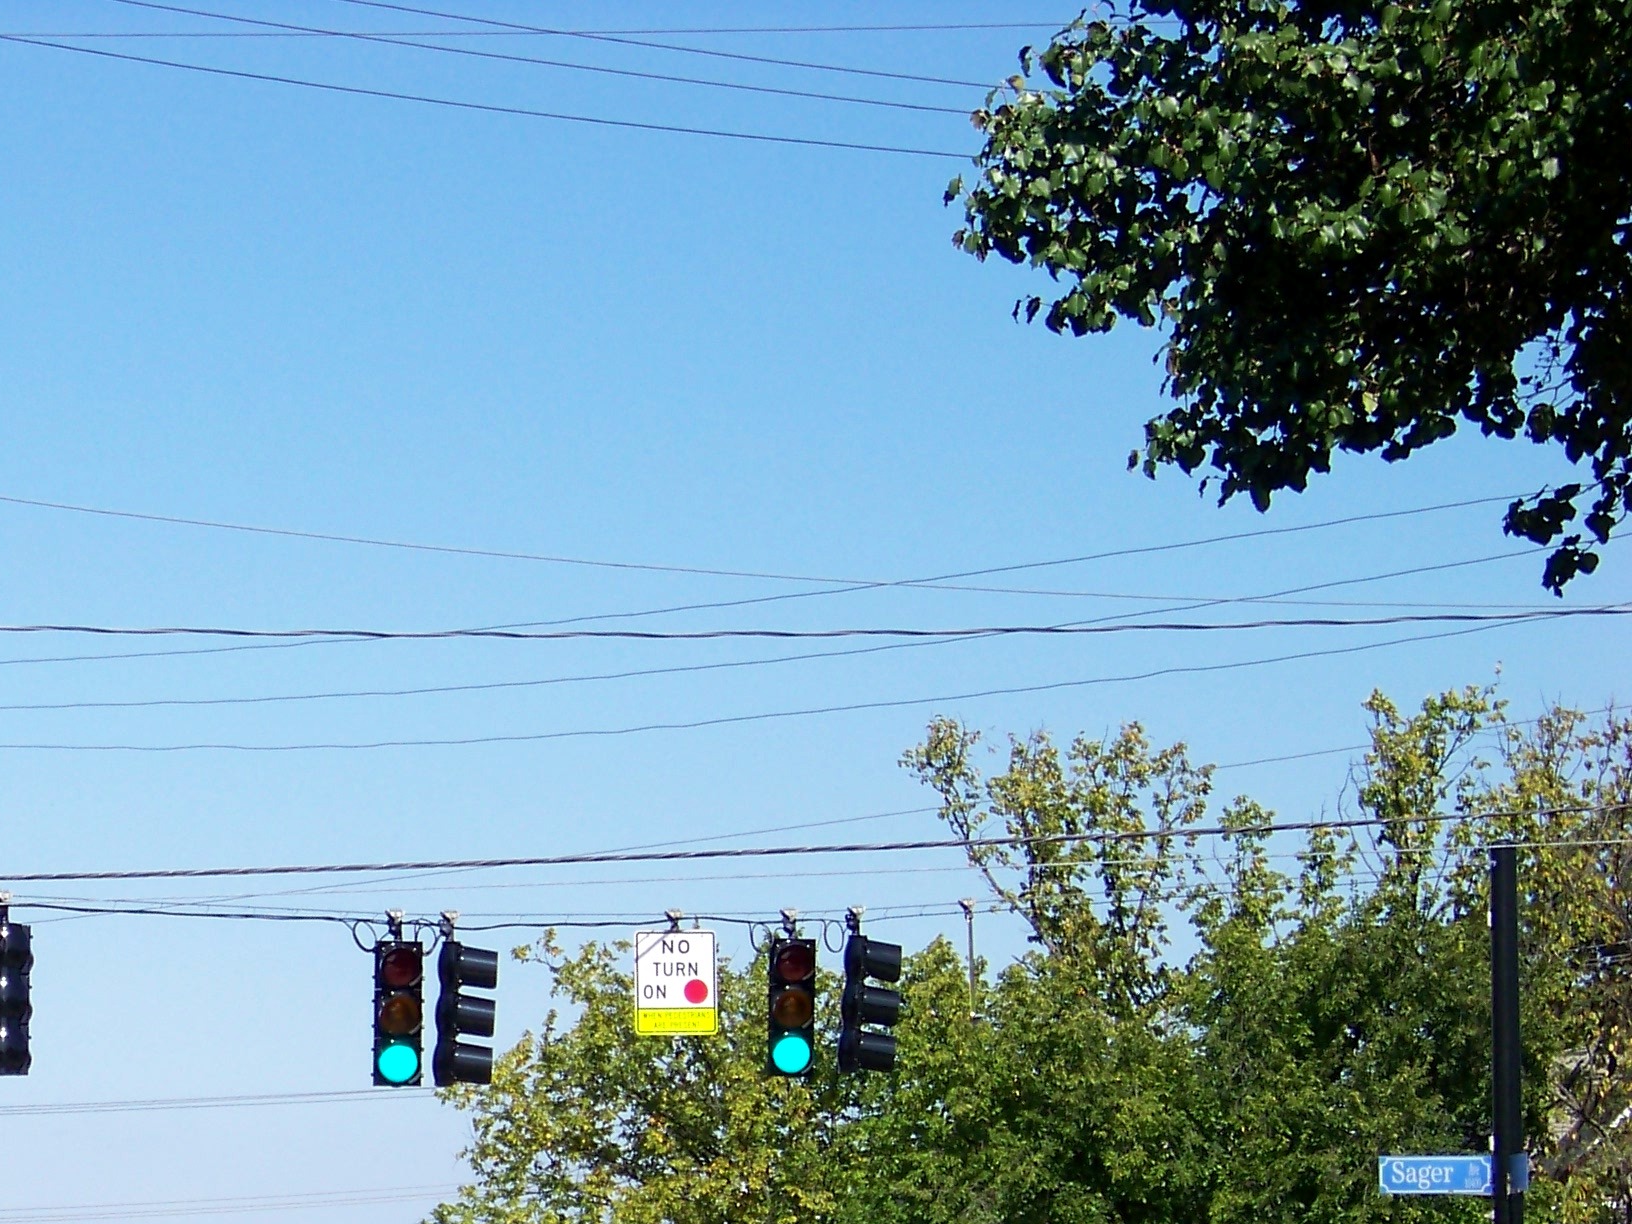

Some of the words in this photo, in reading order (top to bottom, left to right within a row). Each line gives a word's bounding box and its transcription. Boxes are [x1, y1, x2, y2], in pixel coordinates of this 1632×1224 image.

[662, 939, 690, 954] NO
[653, 962, 698, 977] TURN
[644, 984, 666, 999] ON
[1391, 1161, 1454, 1189] Sager
